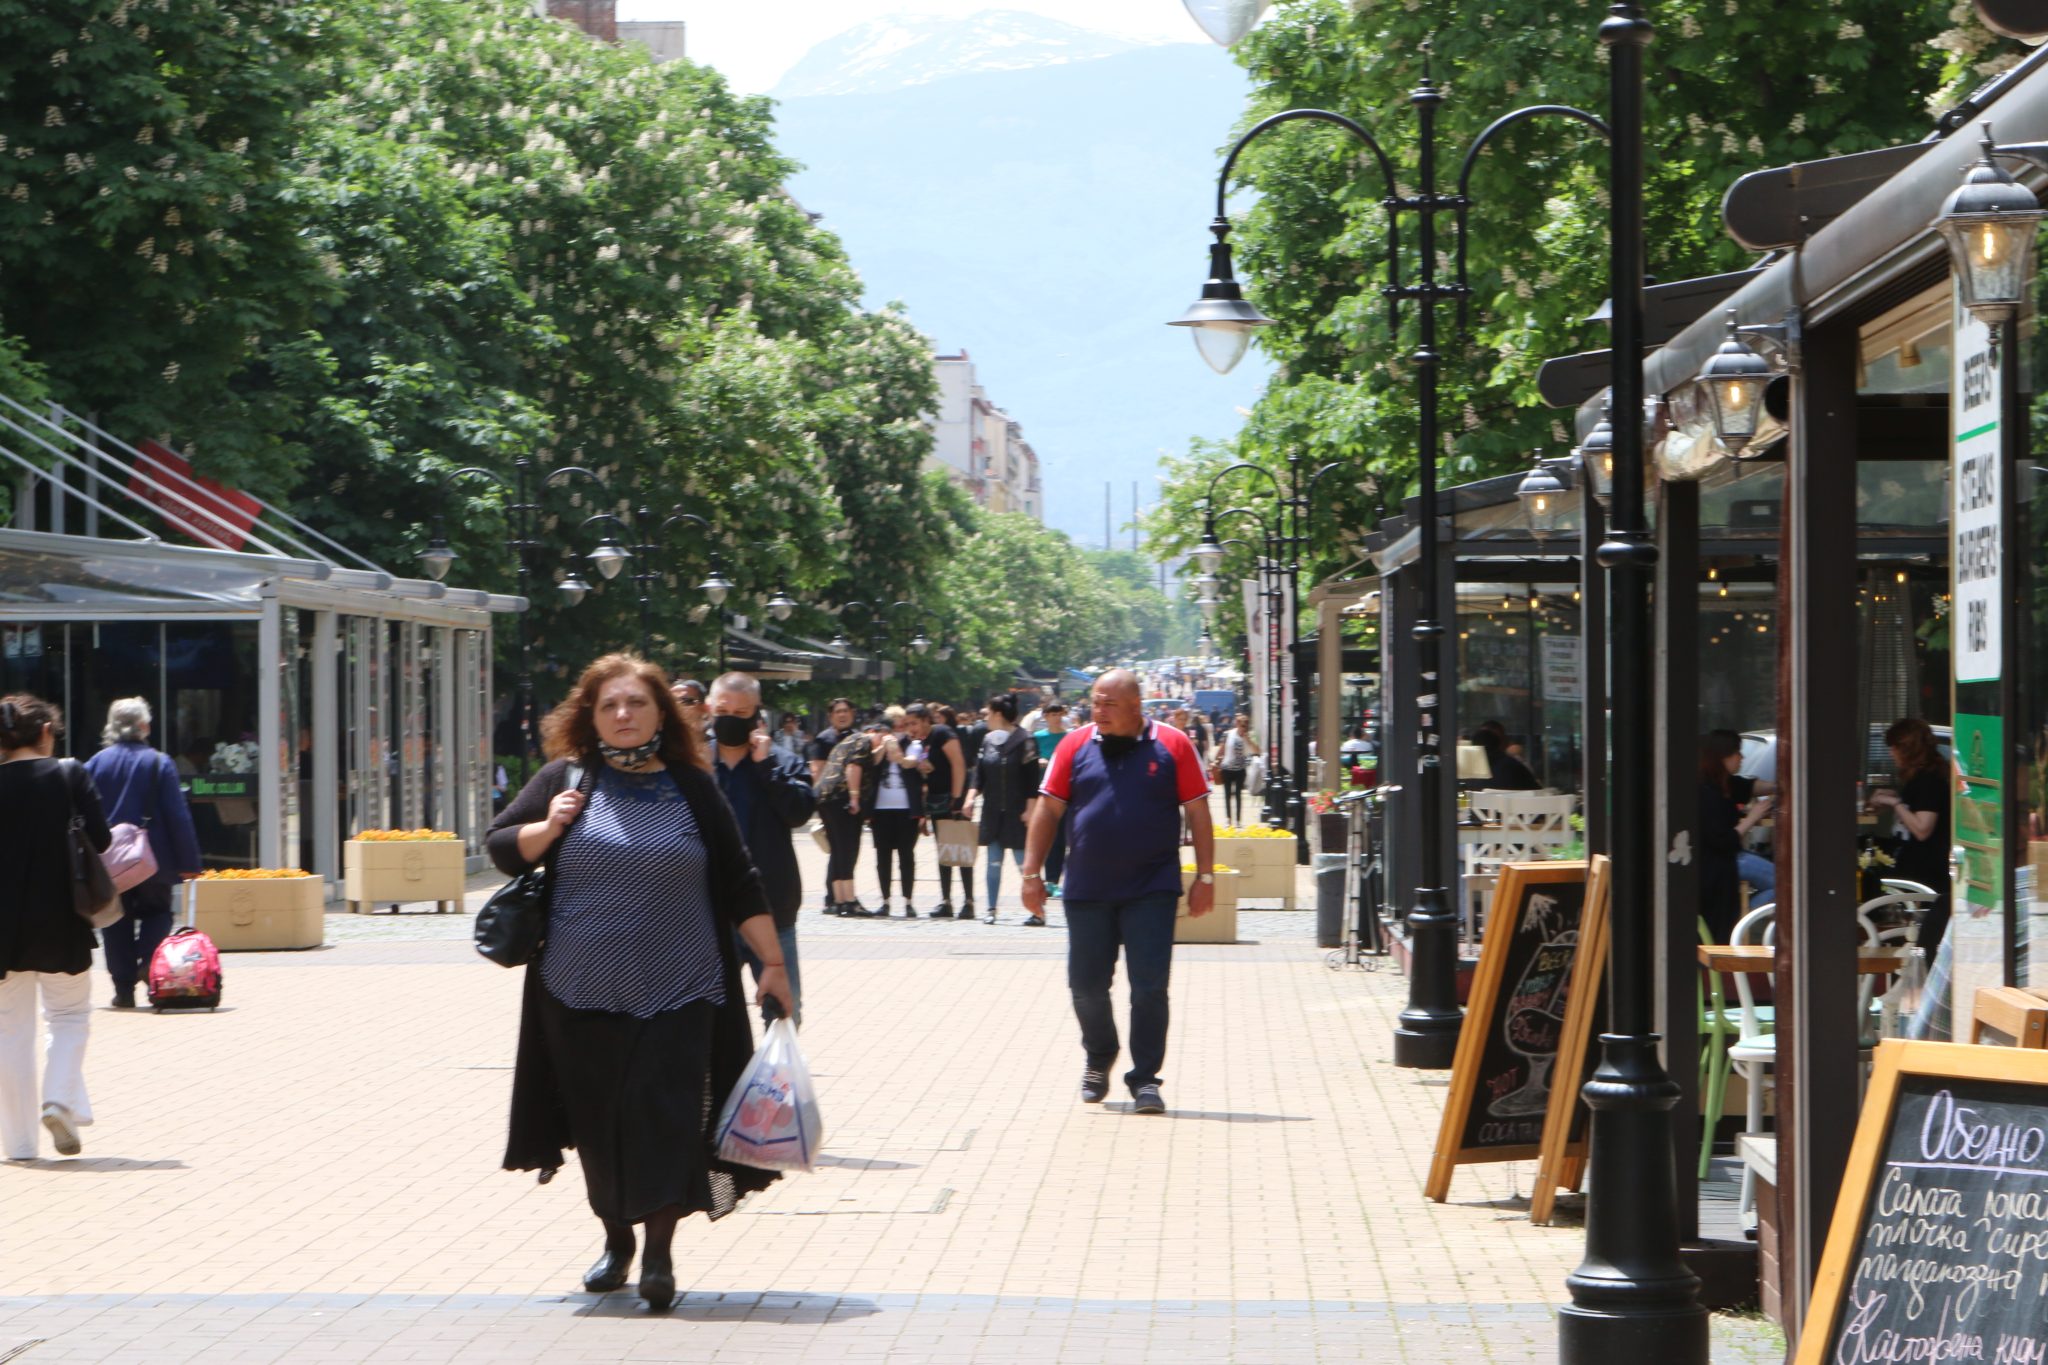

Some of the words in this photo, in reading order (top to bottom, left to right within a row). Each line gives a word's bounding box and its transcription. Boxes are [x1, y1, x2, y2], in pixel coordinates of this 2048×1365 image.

[1960, 451, 1996, 513] STEAKS
[1958, 523, 1998, 585] BURGERS
[1967, 599, 1988, 652] RIBS
[1878, 1166, 1967, 1218] Салата
